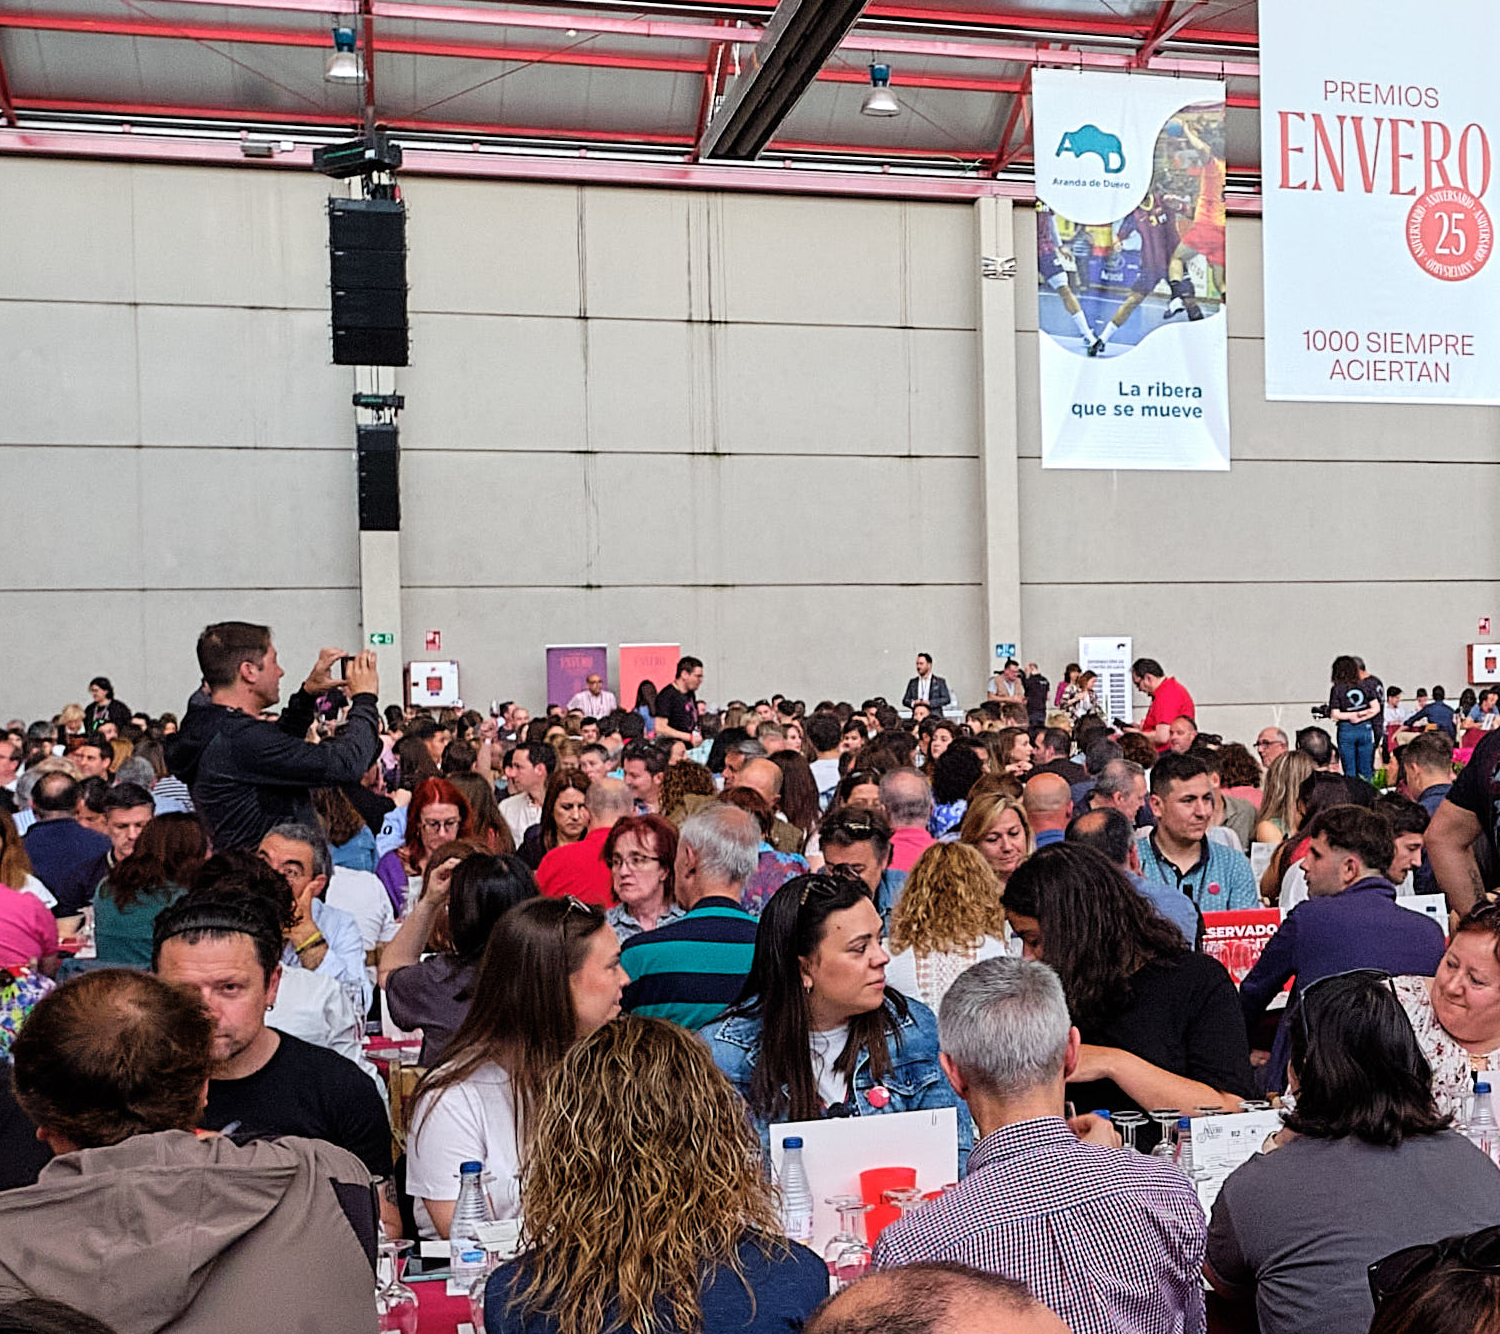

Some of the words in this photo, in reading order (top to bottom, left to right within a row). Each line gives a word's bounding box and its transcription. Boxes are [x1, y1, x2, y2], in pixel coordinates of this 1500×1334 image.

[1323, 80, 1440, 109] PREMIOS
[1276, 110, 1492, 200] ENVERO
[1434, 211, 1466, 256] 25
[1302, 327, 1361, 355] 1000
[1366, 330, 1475, 358] SIEMPRE
[1329, 357, 1451, 384] ACIERTAN
[1119, 380, 1141, 397] La
[1148, 381, 1203, 399] ribera
[1071, 402, 1107, 419] que
[1114, 404, 1134, 417] se
[1141, 405, 1203, 419] mueve
[1206, 923, 1278, 938] SERVADO
